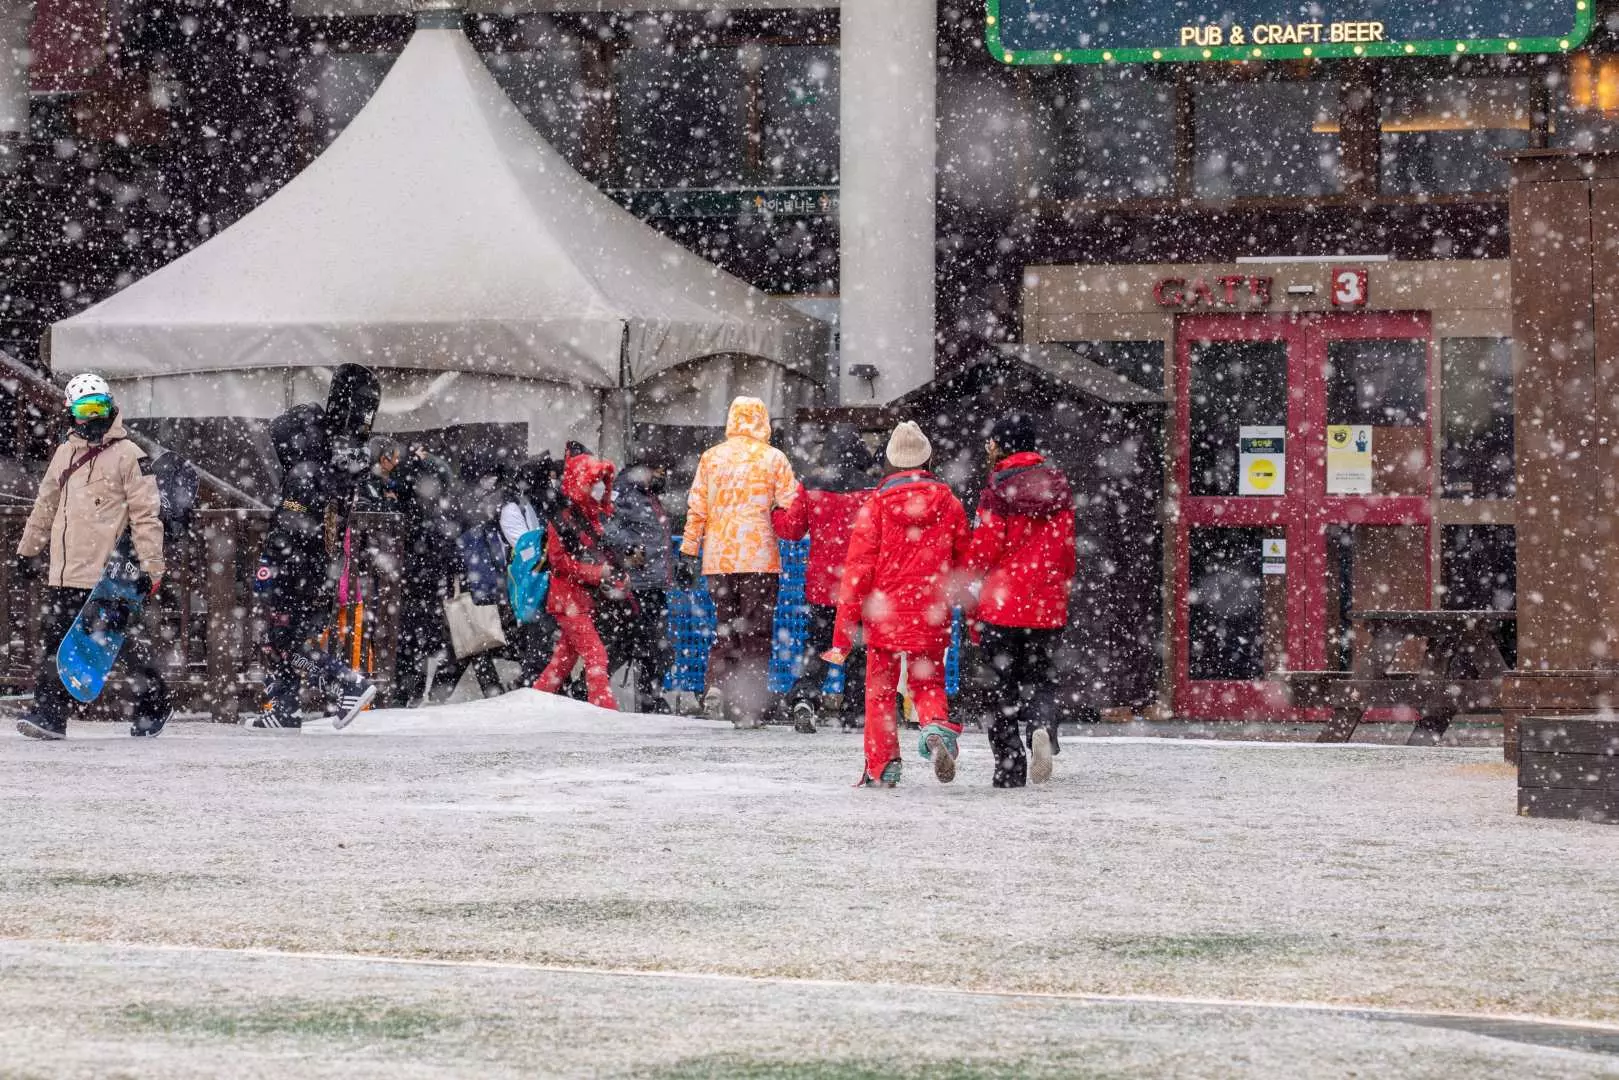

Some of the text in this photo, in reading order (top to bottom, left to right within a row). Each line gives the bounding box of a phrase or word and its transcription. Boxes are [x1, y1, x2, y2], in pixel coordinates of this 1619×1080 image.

[1180, 21, 1385, 46] PUB & CRAFT BEER
[1152, 275, 1273, 306] GATE
[1336, 272, 1360, 303] 3
